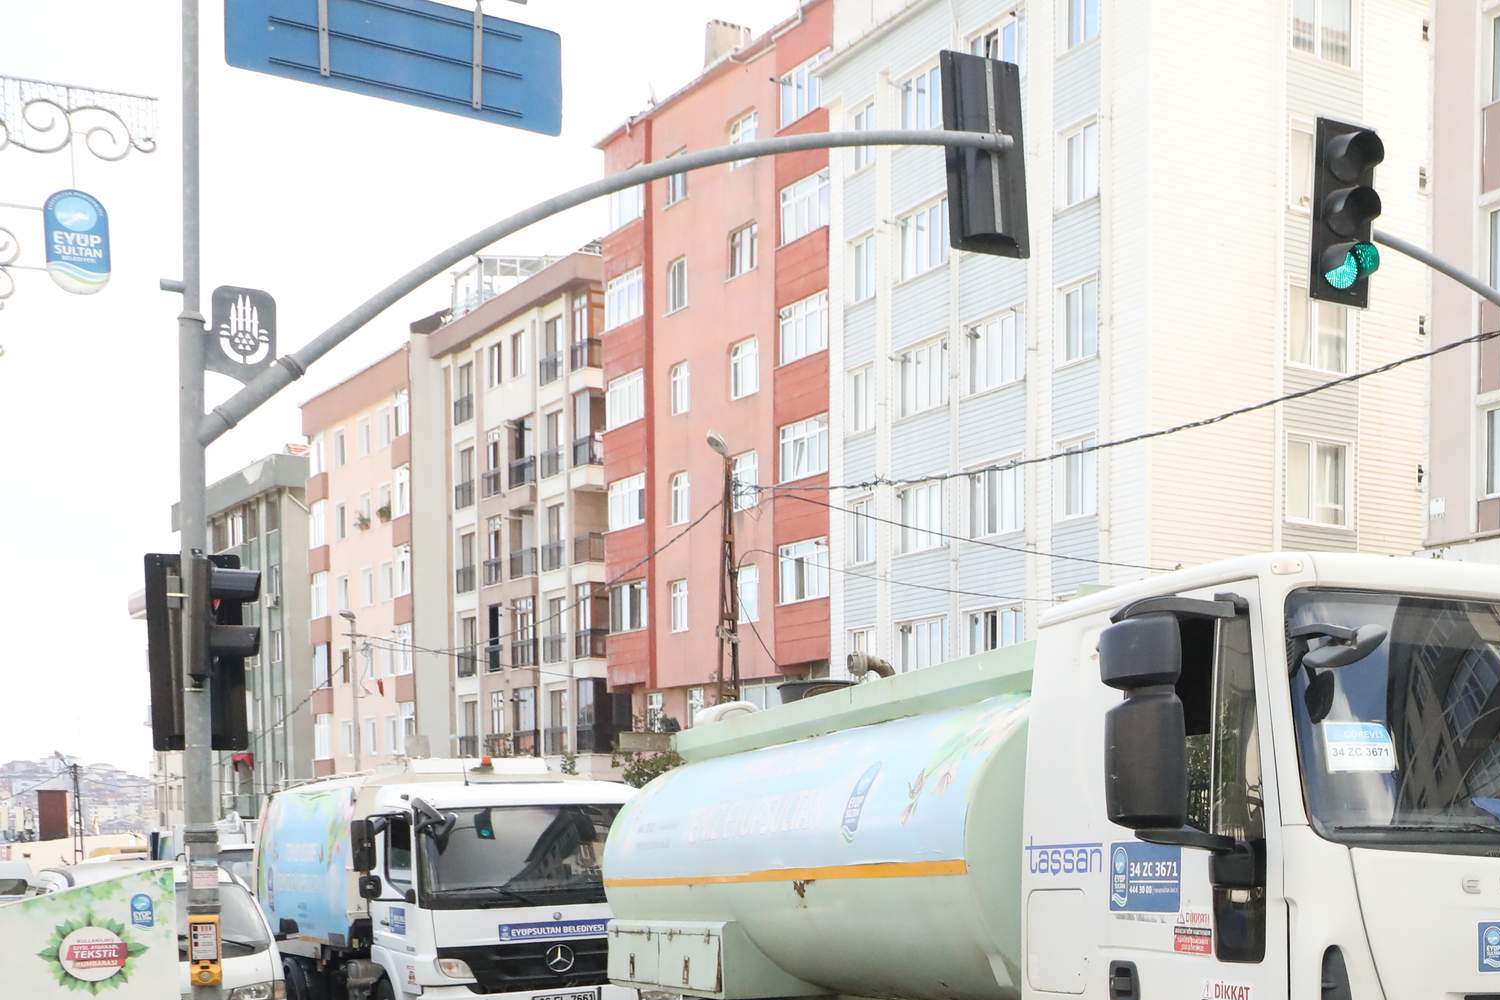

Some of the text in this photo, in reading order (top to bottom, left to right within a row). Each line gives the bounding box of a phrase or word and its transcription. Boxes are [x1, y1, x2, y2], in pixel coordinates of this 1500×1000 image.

[52, 230, 102, 247] EYÜP
[54, 244, 103, 258] SULTAN
[1331, 747, 1389, 757] 34 ZC 3671
[1130, 861, 1178, 877] 34 ZC 3671
[1129, 885, 1139, 894] 444
[511, 924, 605, 937] EYÜPSULTAN BELEDİYESİ
[73, 949, 119, 959] TEKSTİL
